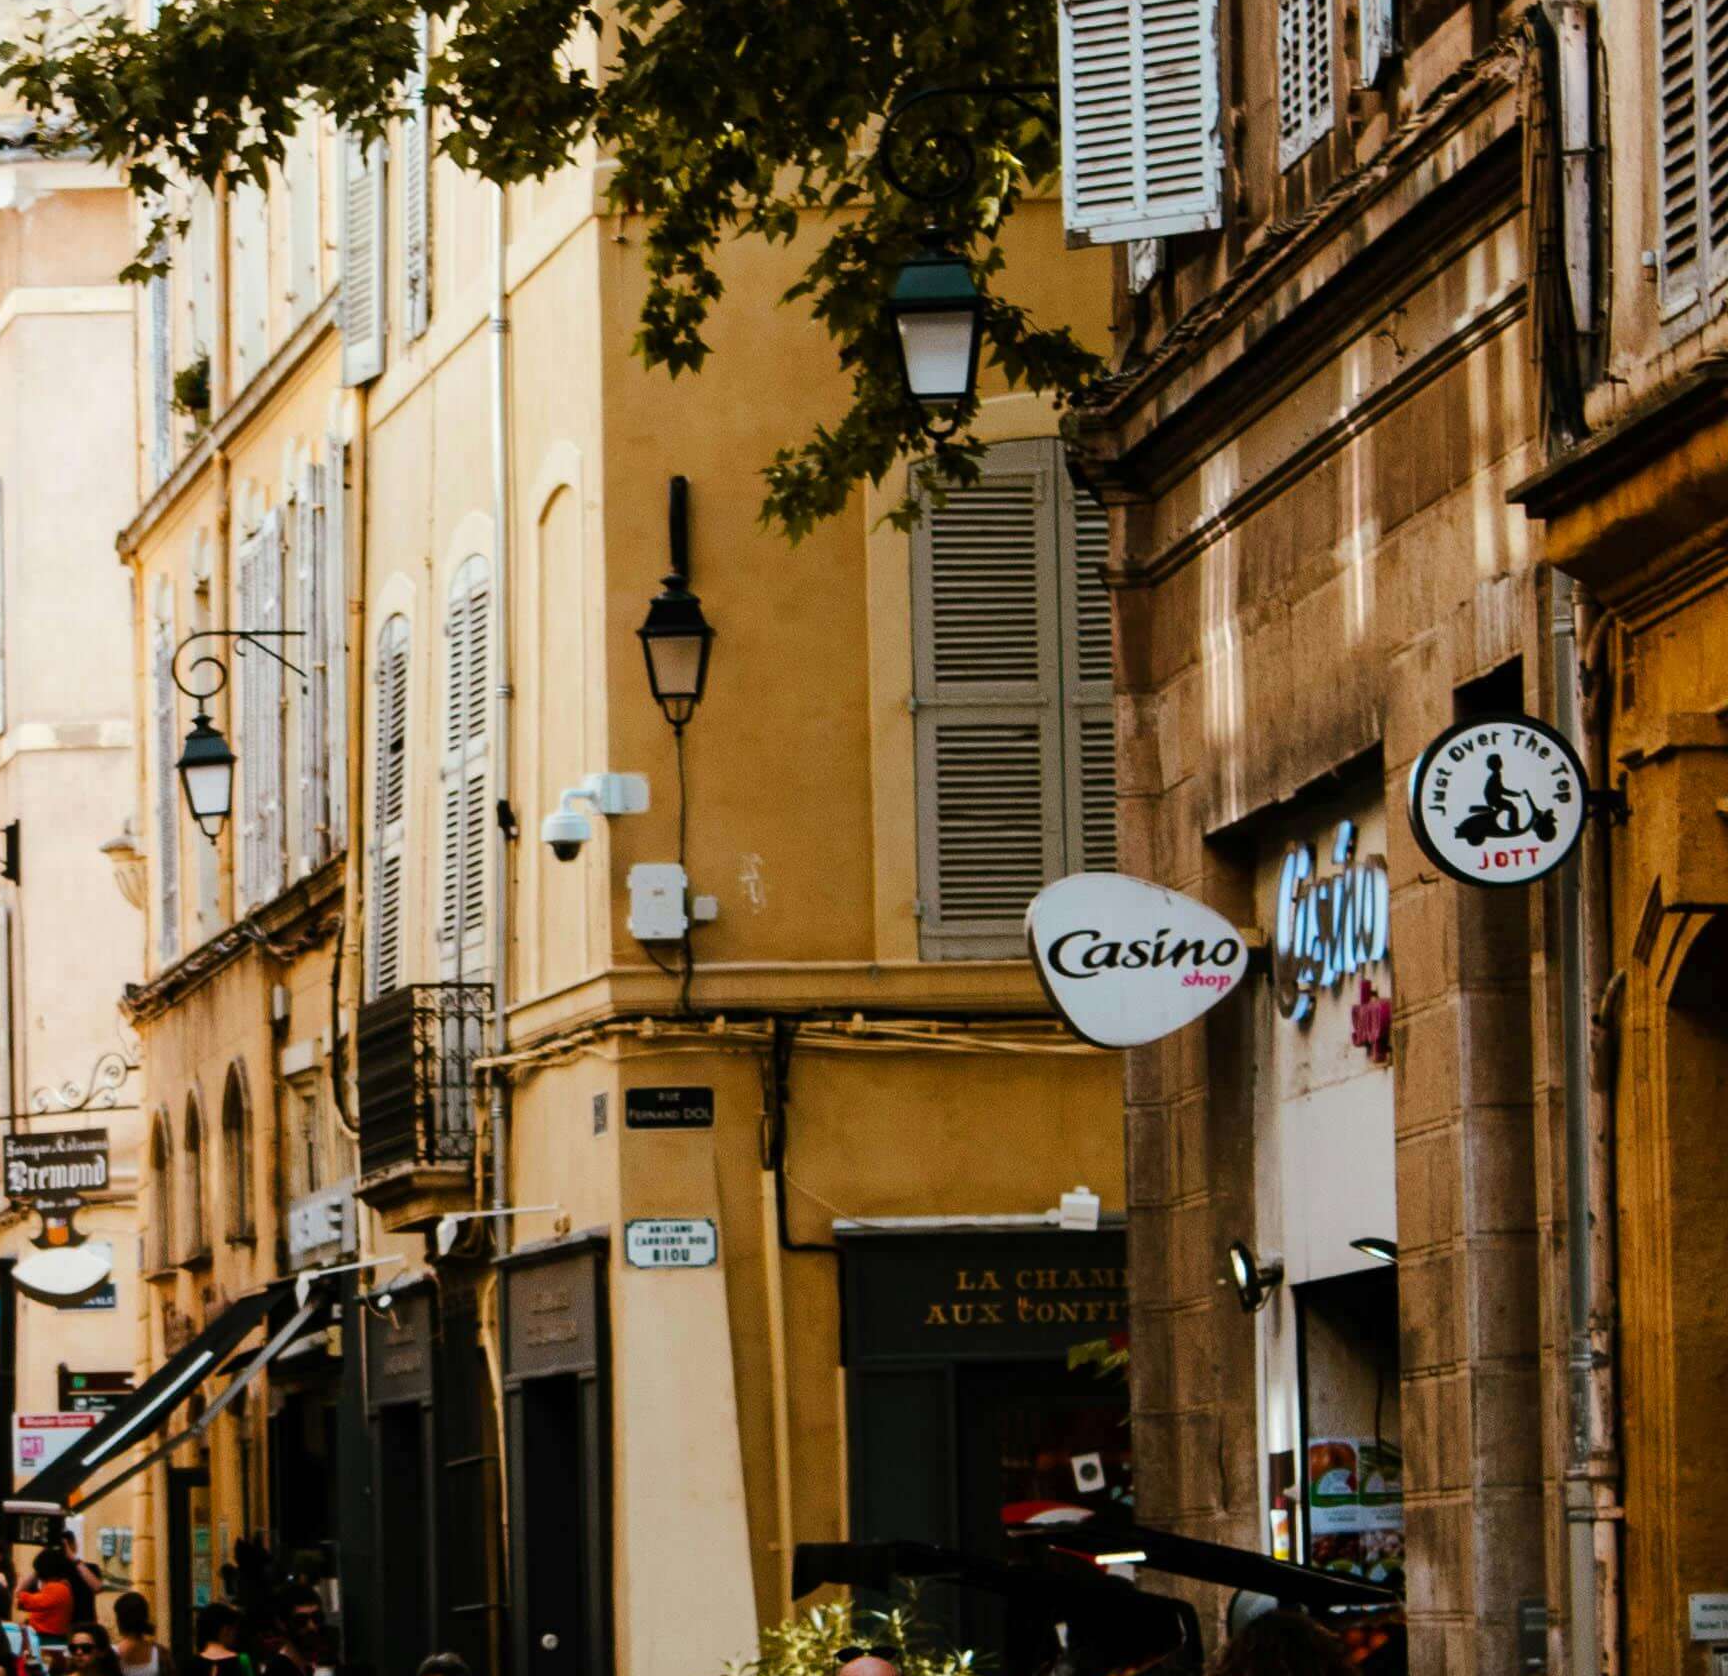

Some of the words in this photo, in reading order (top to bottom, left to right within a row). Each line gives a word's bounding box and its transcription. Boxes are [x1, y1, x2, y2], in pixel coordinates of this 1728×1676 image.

[1428, 767, 1453, 816] Just
[1448, 731, 1501, 762] Over
[1512, 729, 1550, 760] The
[1550, 761, 1572, 804] Top
[1477, 847, 1540, 870] JOTT
[1048, 928, 1240, 979] Casino
[1181, 969, 1231, 993] shop
[658, 1092, 680, 1101] RUE
[683, 1108, 712, 1120] DOL
[8, 1153, 106, 1192] Bremond
[653, 1249, 690, 1262] BIOU
[955, 1269, 1004, 1292] LA
[924, 1301, 1006, 1325] AUX
